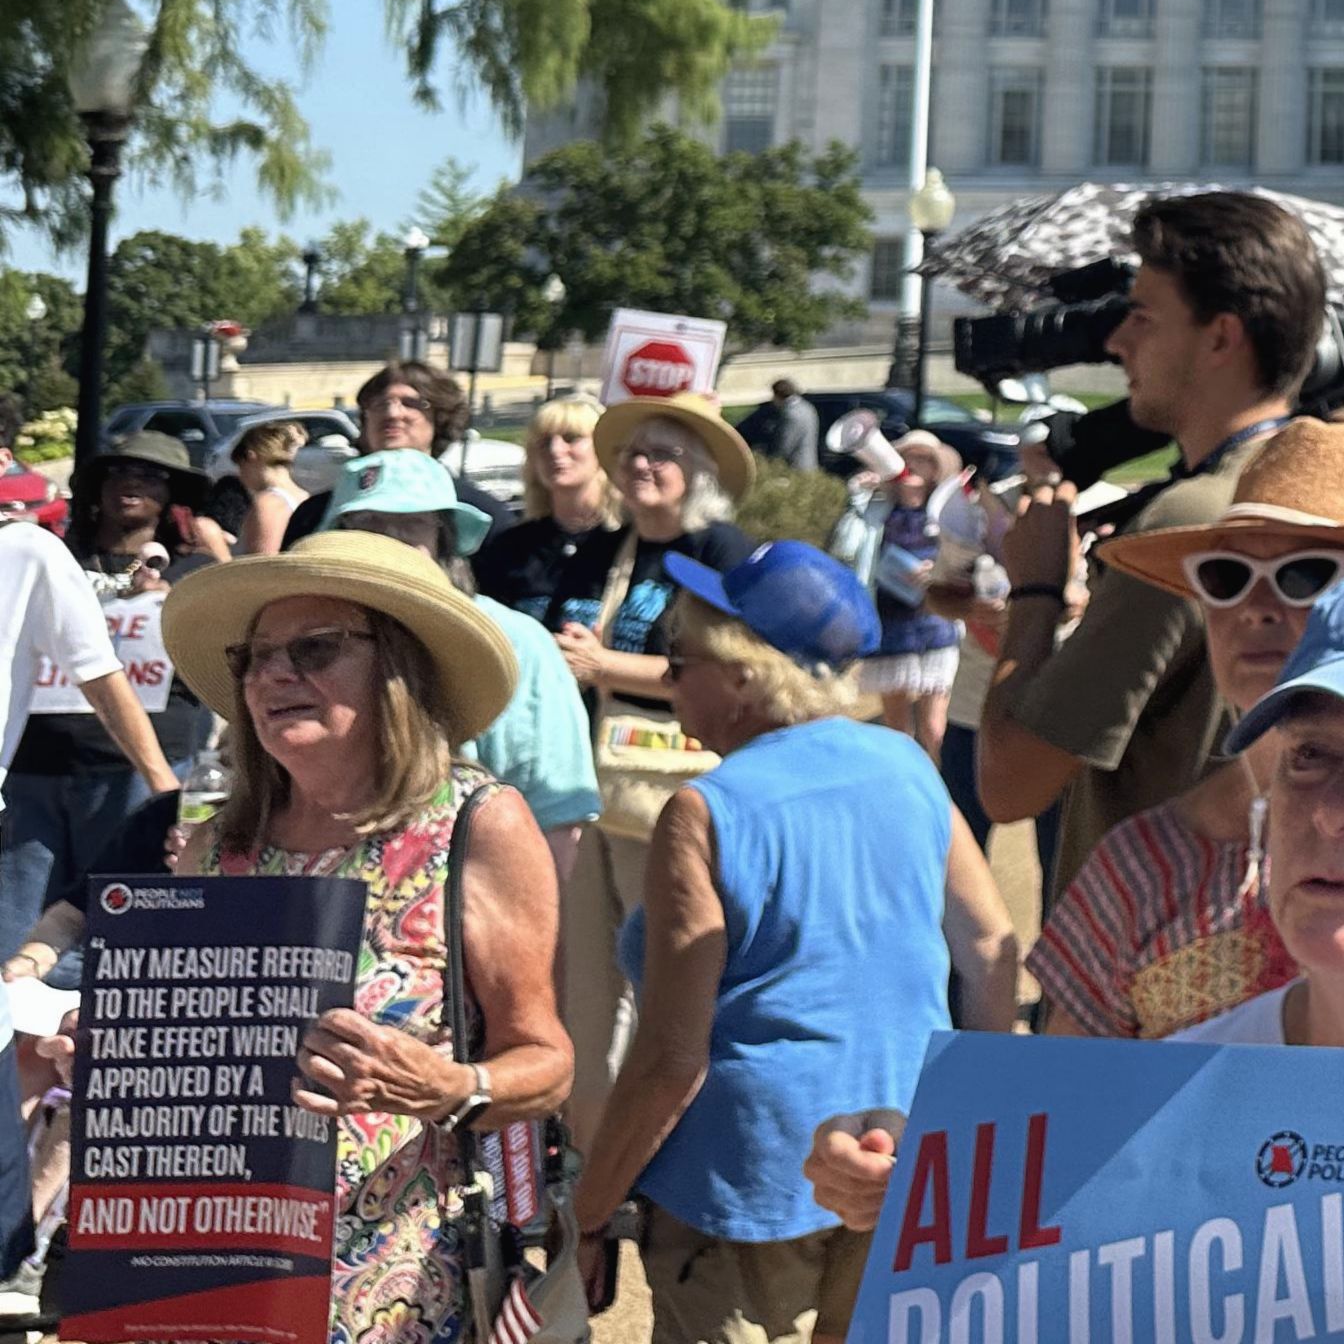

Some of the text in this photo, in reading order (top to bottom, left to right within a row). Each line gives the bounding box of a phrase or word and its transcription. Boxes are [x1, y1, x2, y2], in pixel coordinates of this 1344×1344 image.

[627, 357, 693, 390] STOP
[148, 946, 258, 979] MEASURE
[262, 946, 353, 983] REFERRED
[94, 986, 320, 1019] TO THE PEOPLE SHALL
[90, 1026, 299, 1060] TAKE EFFECT WHEN
[86, 1065, 265, 1100] APPROVED BY A
[85, 1105, 330, 1144] MAJORITY OF THE VOTES
[84, 1144, 252, 1181] CAST THEREON,
[892, 1113, 1061, 1272] ALL
[77, 1197, 134, 1235] AND
[138, 1197, 192, 1234] NOT
